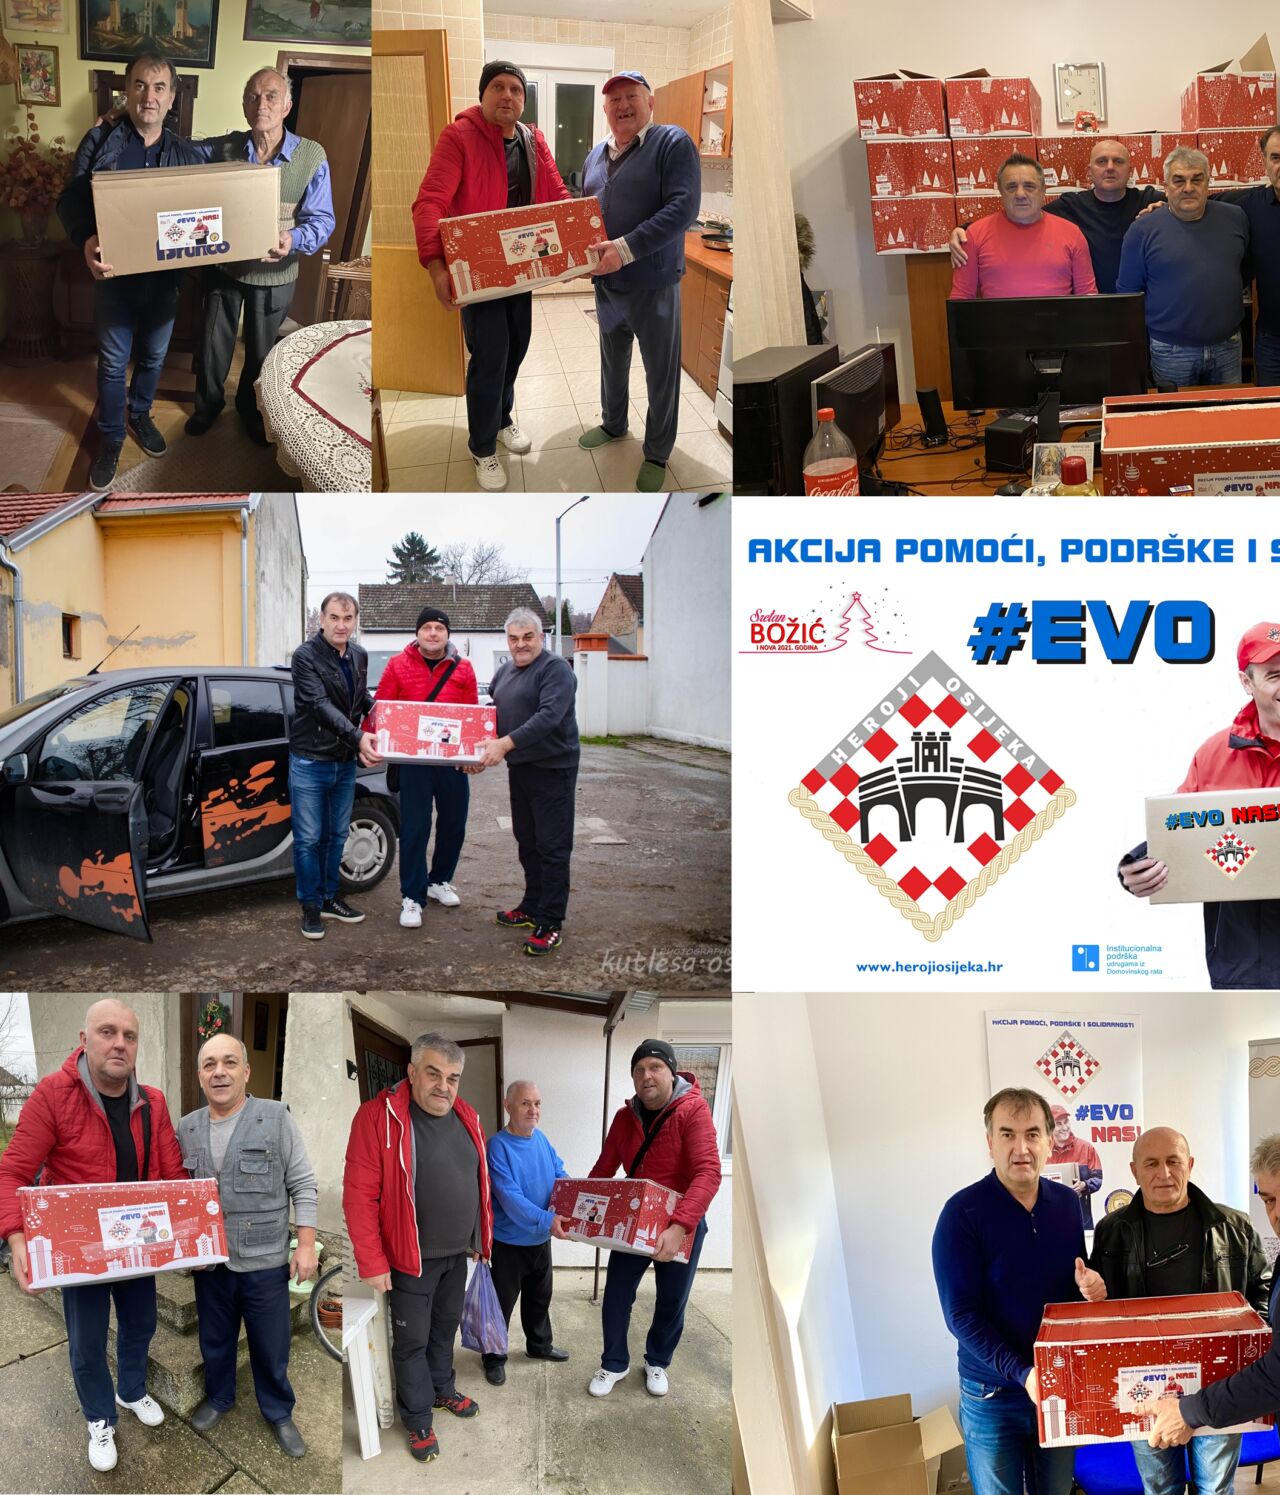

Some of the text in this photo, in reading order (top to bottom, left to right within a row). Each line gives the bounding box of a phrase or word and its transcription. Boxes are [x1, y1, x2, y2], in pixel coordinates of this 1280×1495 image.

[1224, 483, 1254, 492] #EVO
[748, 538, 881, 563] AKCIJA
[896, 533, 1046, 567] POMOĆI,
[1061, 533, 1233, 563] PODRŠKE
[1248, 538, 1256, 563] I
[750, 608, 786, 622] Sretan
[751, 617, 825, 644] BOŽIĆ
[966, 600, 1216, 666] #EVO
[830, 675, 1037, 770] HEROJI OSIJEKA
[1165, 809, 1225, 830] #EVO
[856, 960, 1003, 975] www.herojiosijeka.hr
[1106, 968, 1149, 976] Domovinskog
[1075, 1104, 1134, 1121] #EVO
[1143, 1372, 1198, 1382] #EVO NAS!
